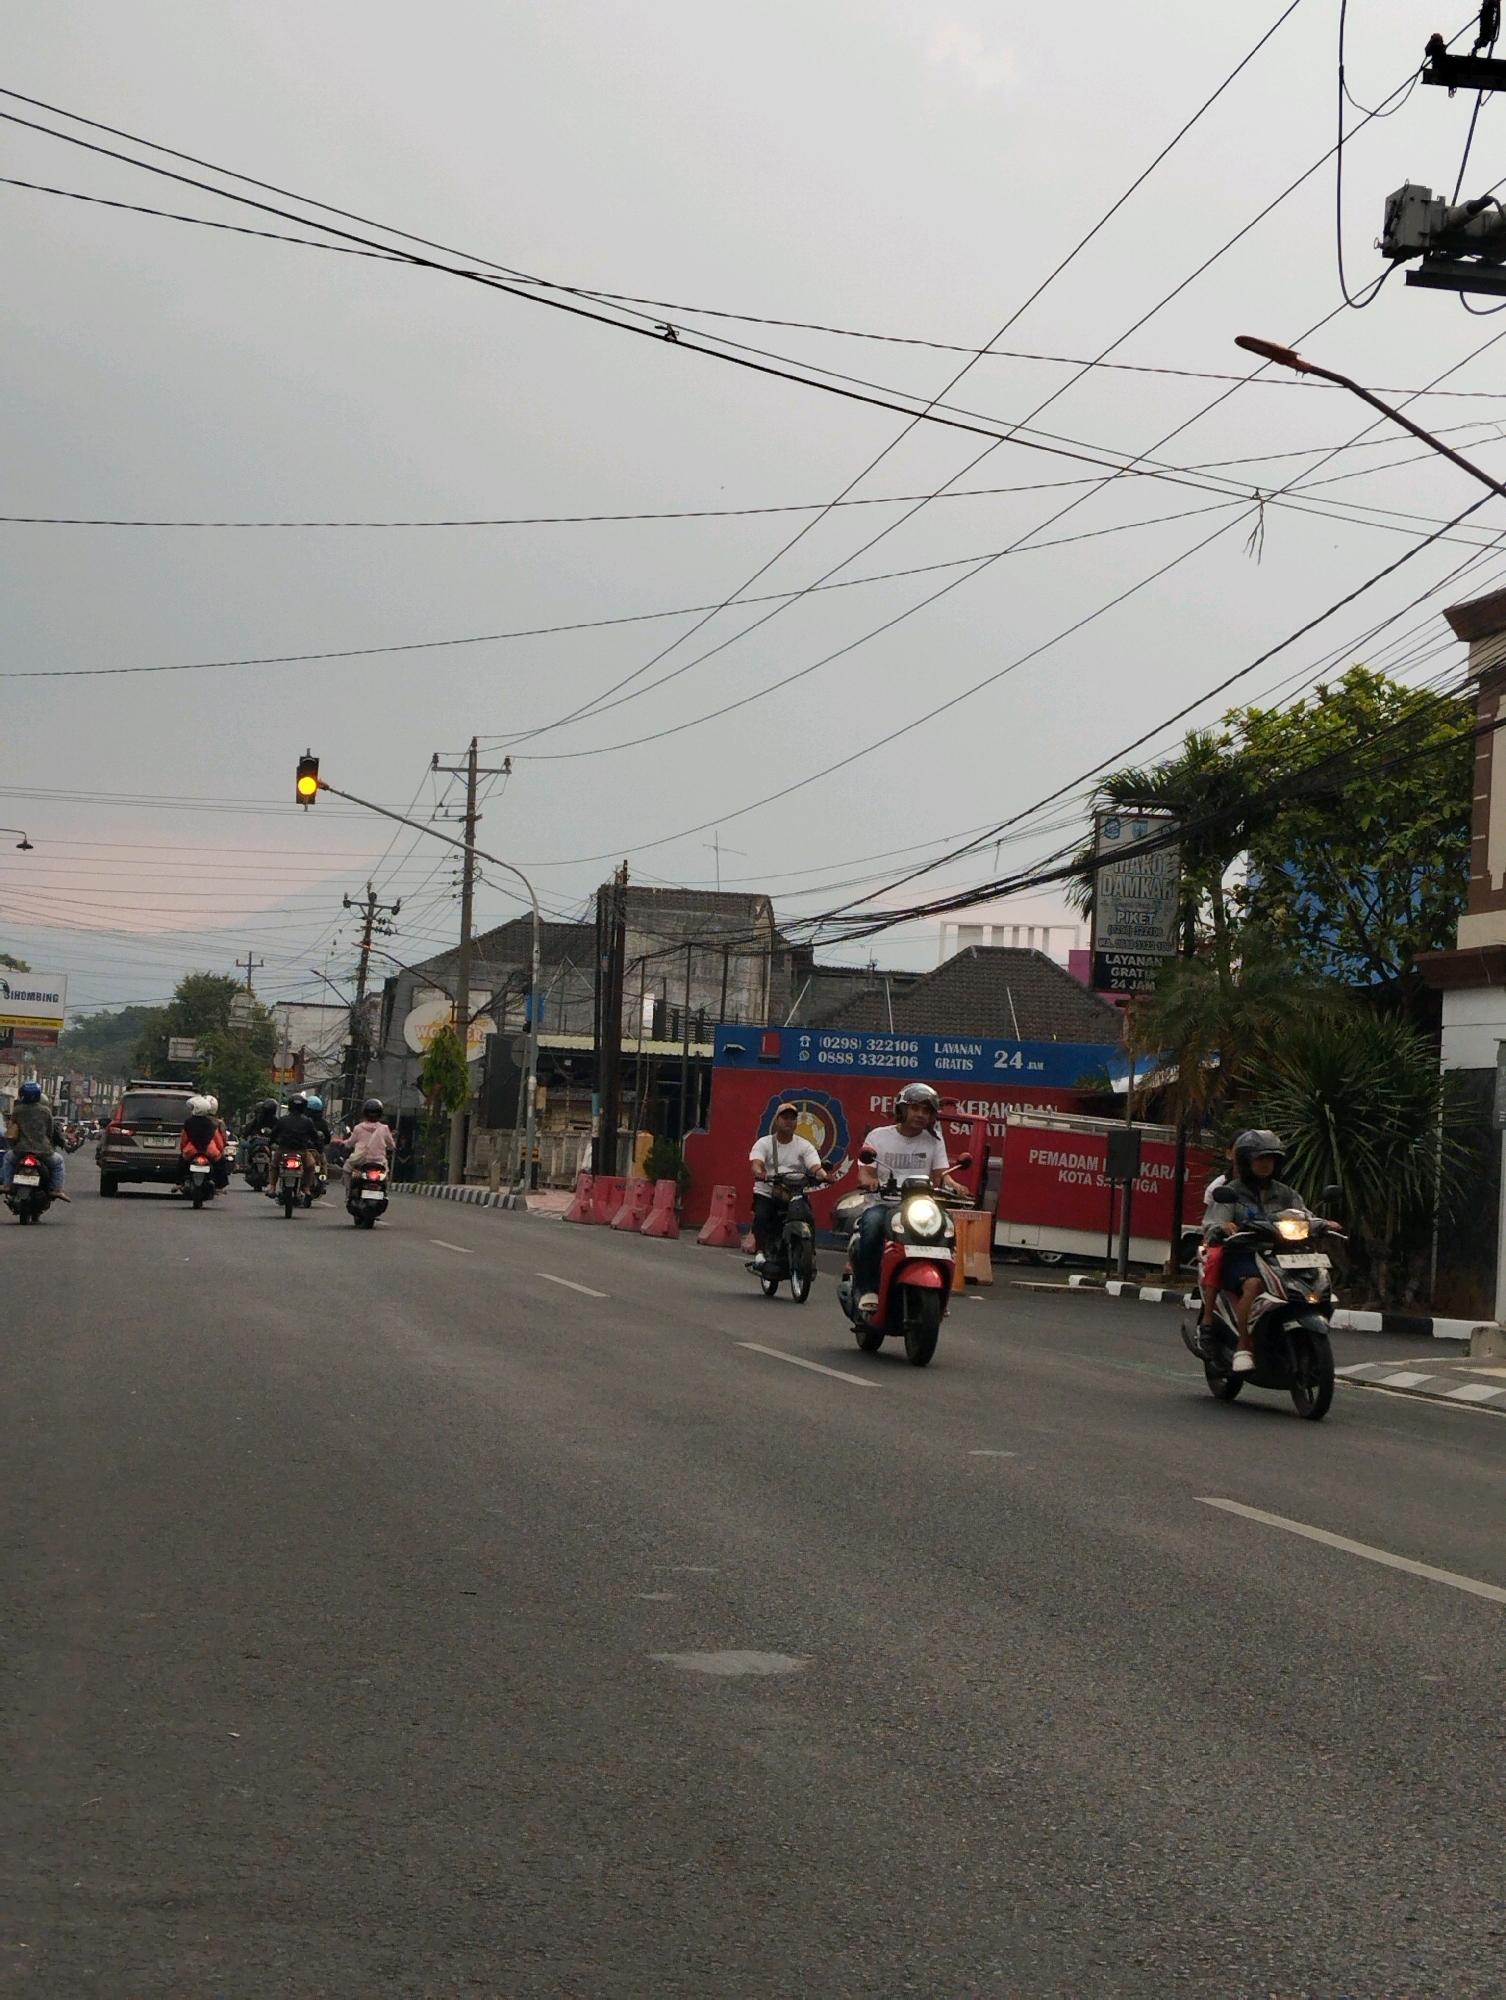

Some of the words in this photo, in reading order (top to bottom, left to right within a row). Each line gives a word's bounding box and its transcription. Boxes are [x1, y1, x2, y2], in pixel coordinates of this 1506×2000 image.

[1117, 911, 1156, 925] PIKET
[1105, 953, 1163, 968] LAYANAN
[1110, 978, 1126, 990] 24
[1129, 980, 1156, 991] JAM
[819, 1036, 862, 1050] (0298)
[866, 1038, 919, 1053] 322106
[934, 1042, 982, 1056] LAYANAN
[818, 1051, 854, 1065] 0888
[858, 1053, 919, 1068] 3322106
[935, 1057, 974, 1071] GRATIS
[993, 1050, 1024, 1069] 24
[1026, 1061, 1044, 1071] JAM
[1029, 1149, 1098, 1172] PEMADAM
[1058, 1170, 1092, 1186] KOTA
